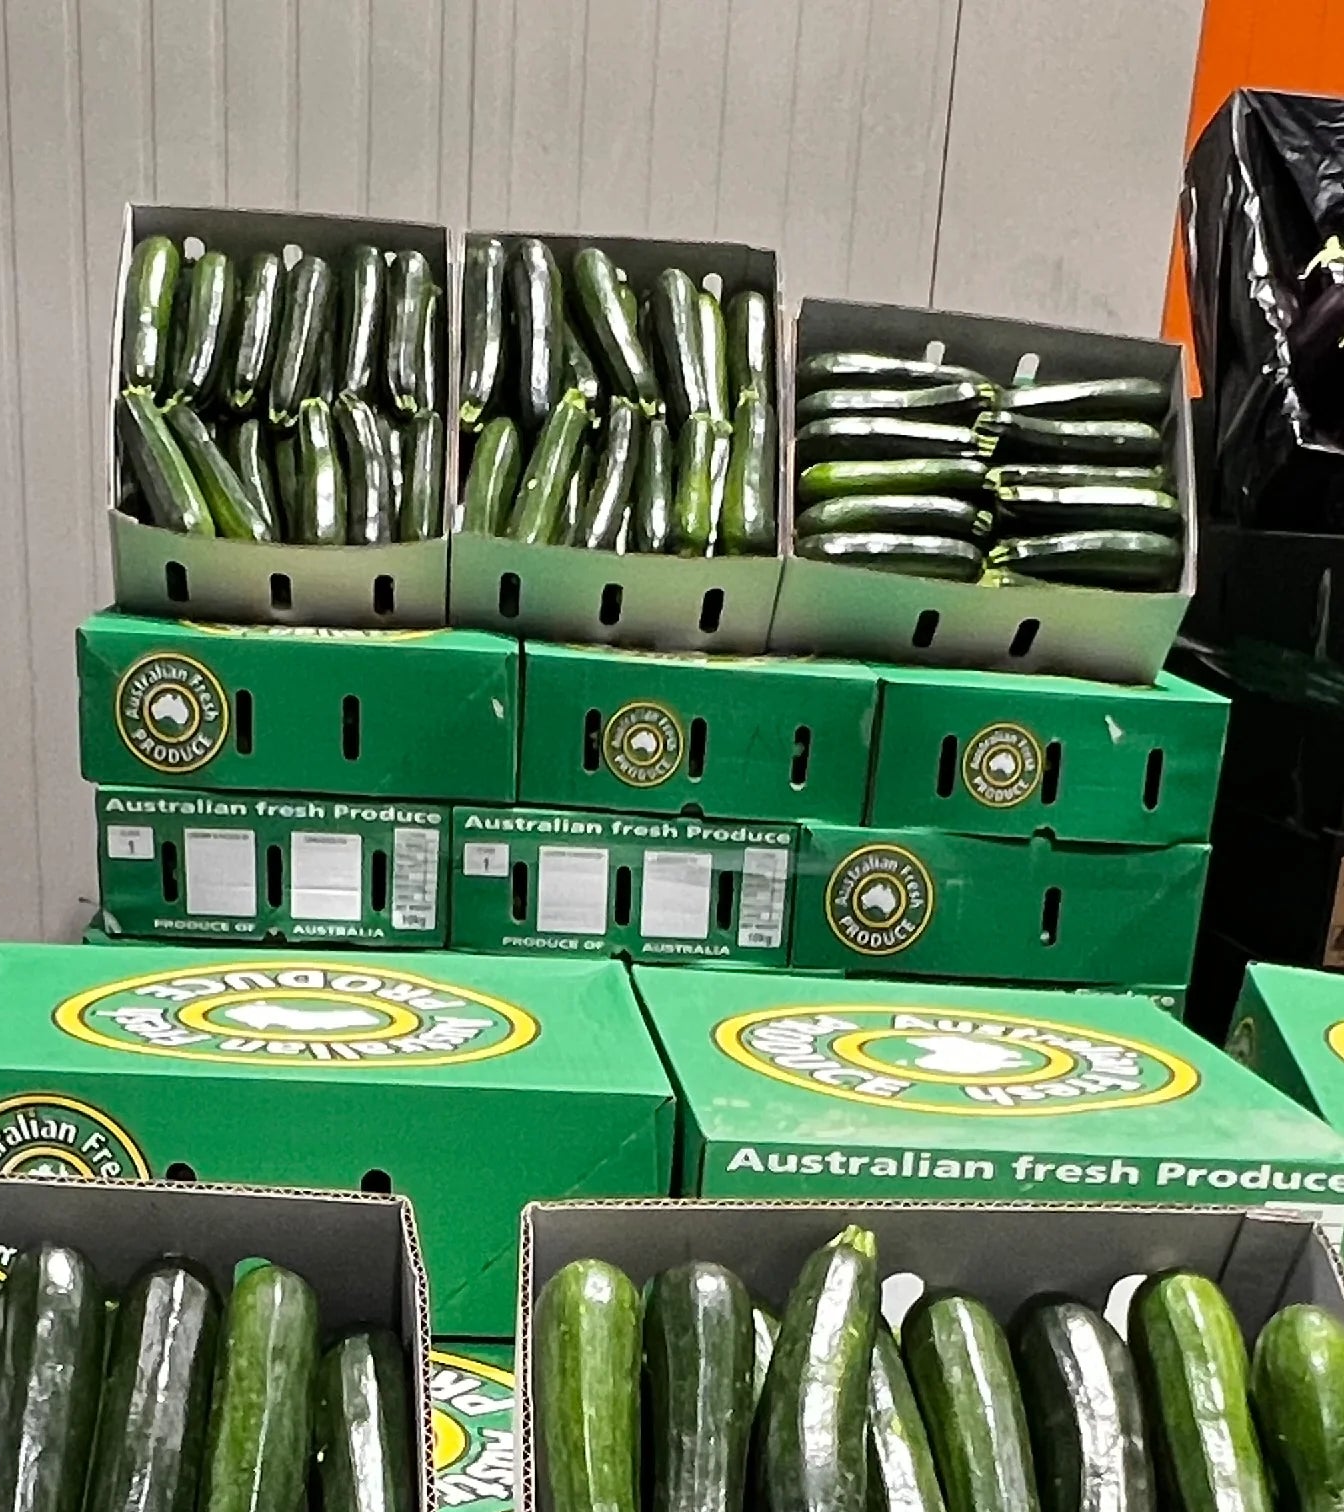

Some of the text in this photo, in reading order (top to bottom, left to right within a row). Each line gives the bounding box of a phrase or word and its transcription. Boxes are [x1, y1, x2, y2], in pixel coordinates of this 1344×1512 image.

[125, 664, 220, 722] Australian Fresh
[133, 728, 214, 764] PRODUCE
[106, 798, 442, 825] Australian fresh Produce
[464, 814, 791, 844] Australian fresh Produce
[834, 854, 898, 906] Australian
[154, 919, 230, 932] PRODUCE
[293, 925, 385, 938] AUSTRALIA
[502, 936, 579, 950] PRODUCE
[642, 943, 730, 956] AUSTRALIA
[838, 915, 916, 948] PRODUCE
[135, 968, 467, 1011] PRODUCE
[81, 1132, 122, 1176] Fre
[726, 1147, 995, 1180] Australian
[1012, 1155, 1140, 1185] fresh
